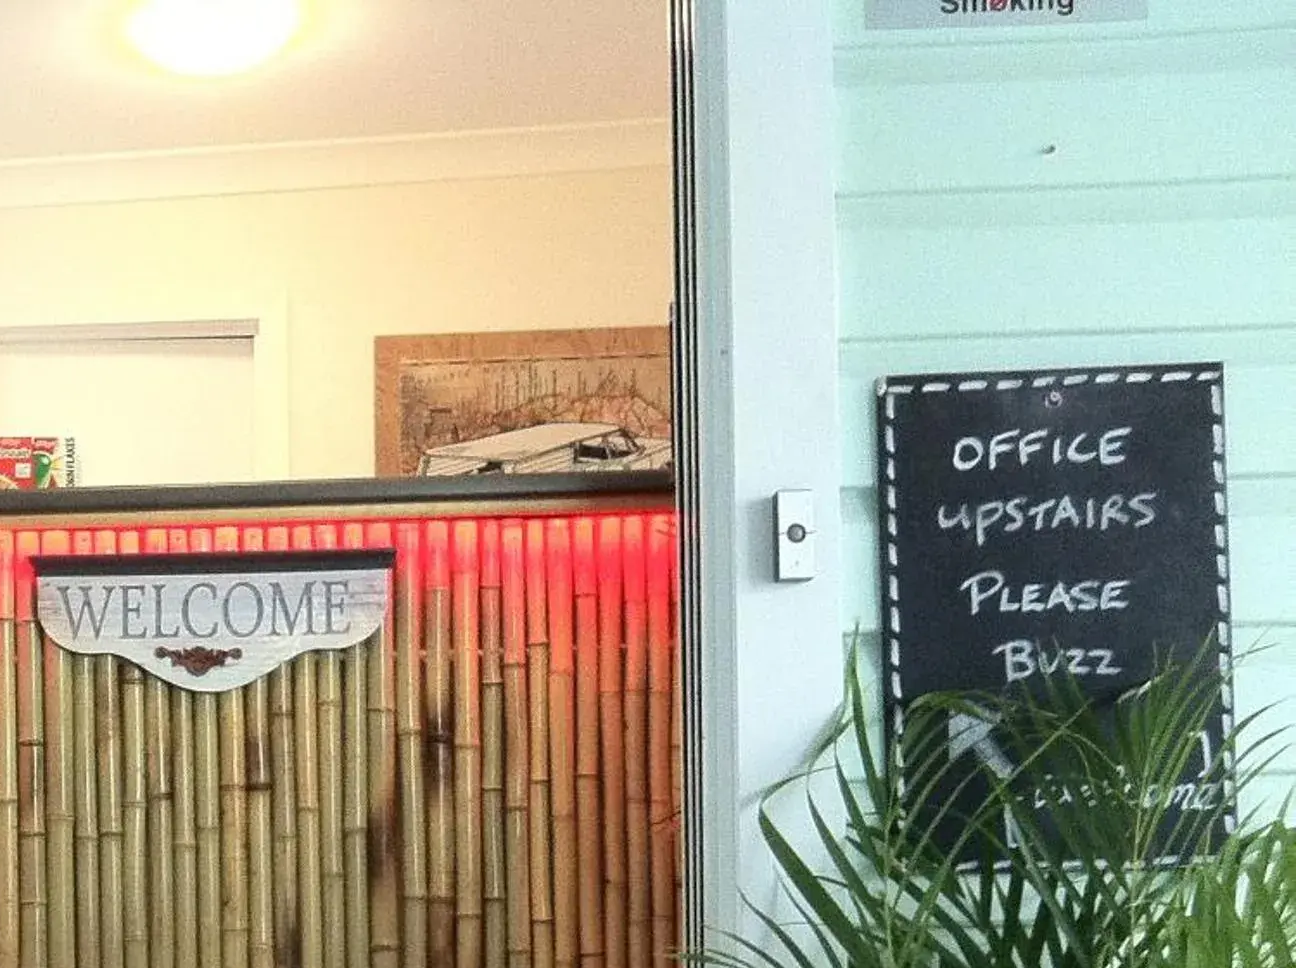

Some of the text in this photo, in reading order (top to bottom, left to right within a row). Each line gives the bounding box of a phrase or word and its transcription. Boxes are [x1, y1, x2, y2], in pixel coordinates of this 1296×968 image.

[952, 427, 1133, 470] OFFICE
[56, 580, 352, 641] WELCOME
[959, 570, 1132, 616] PLEASE
[992, 639, 1123, 683] BUZZ
